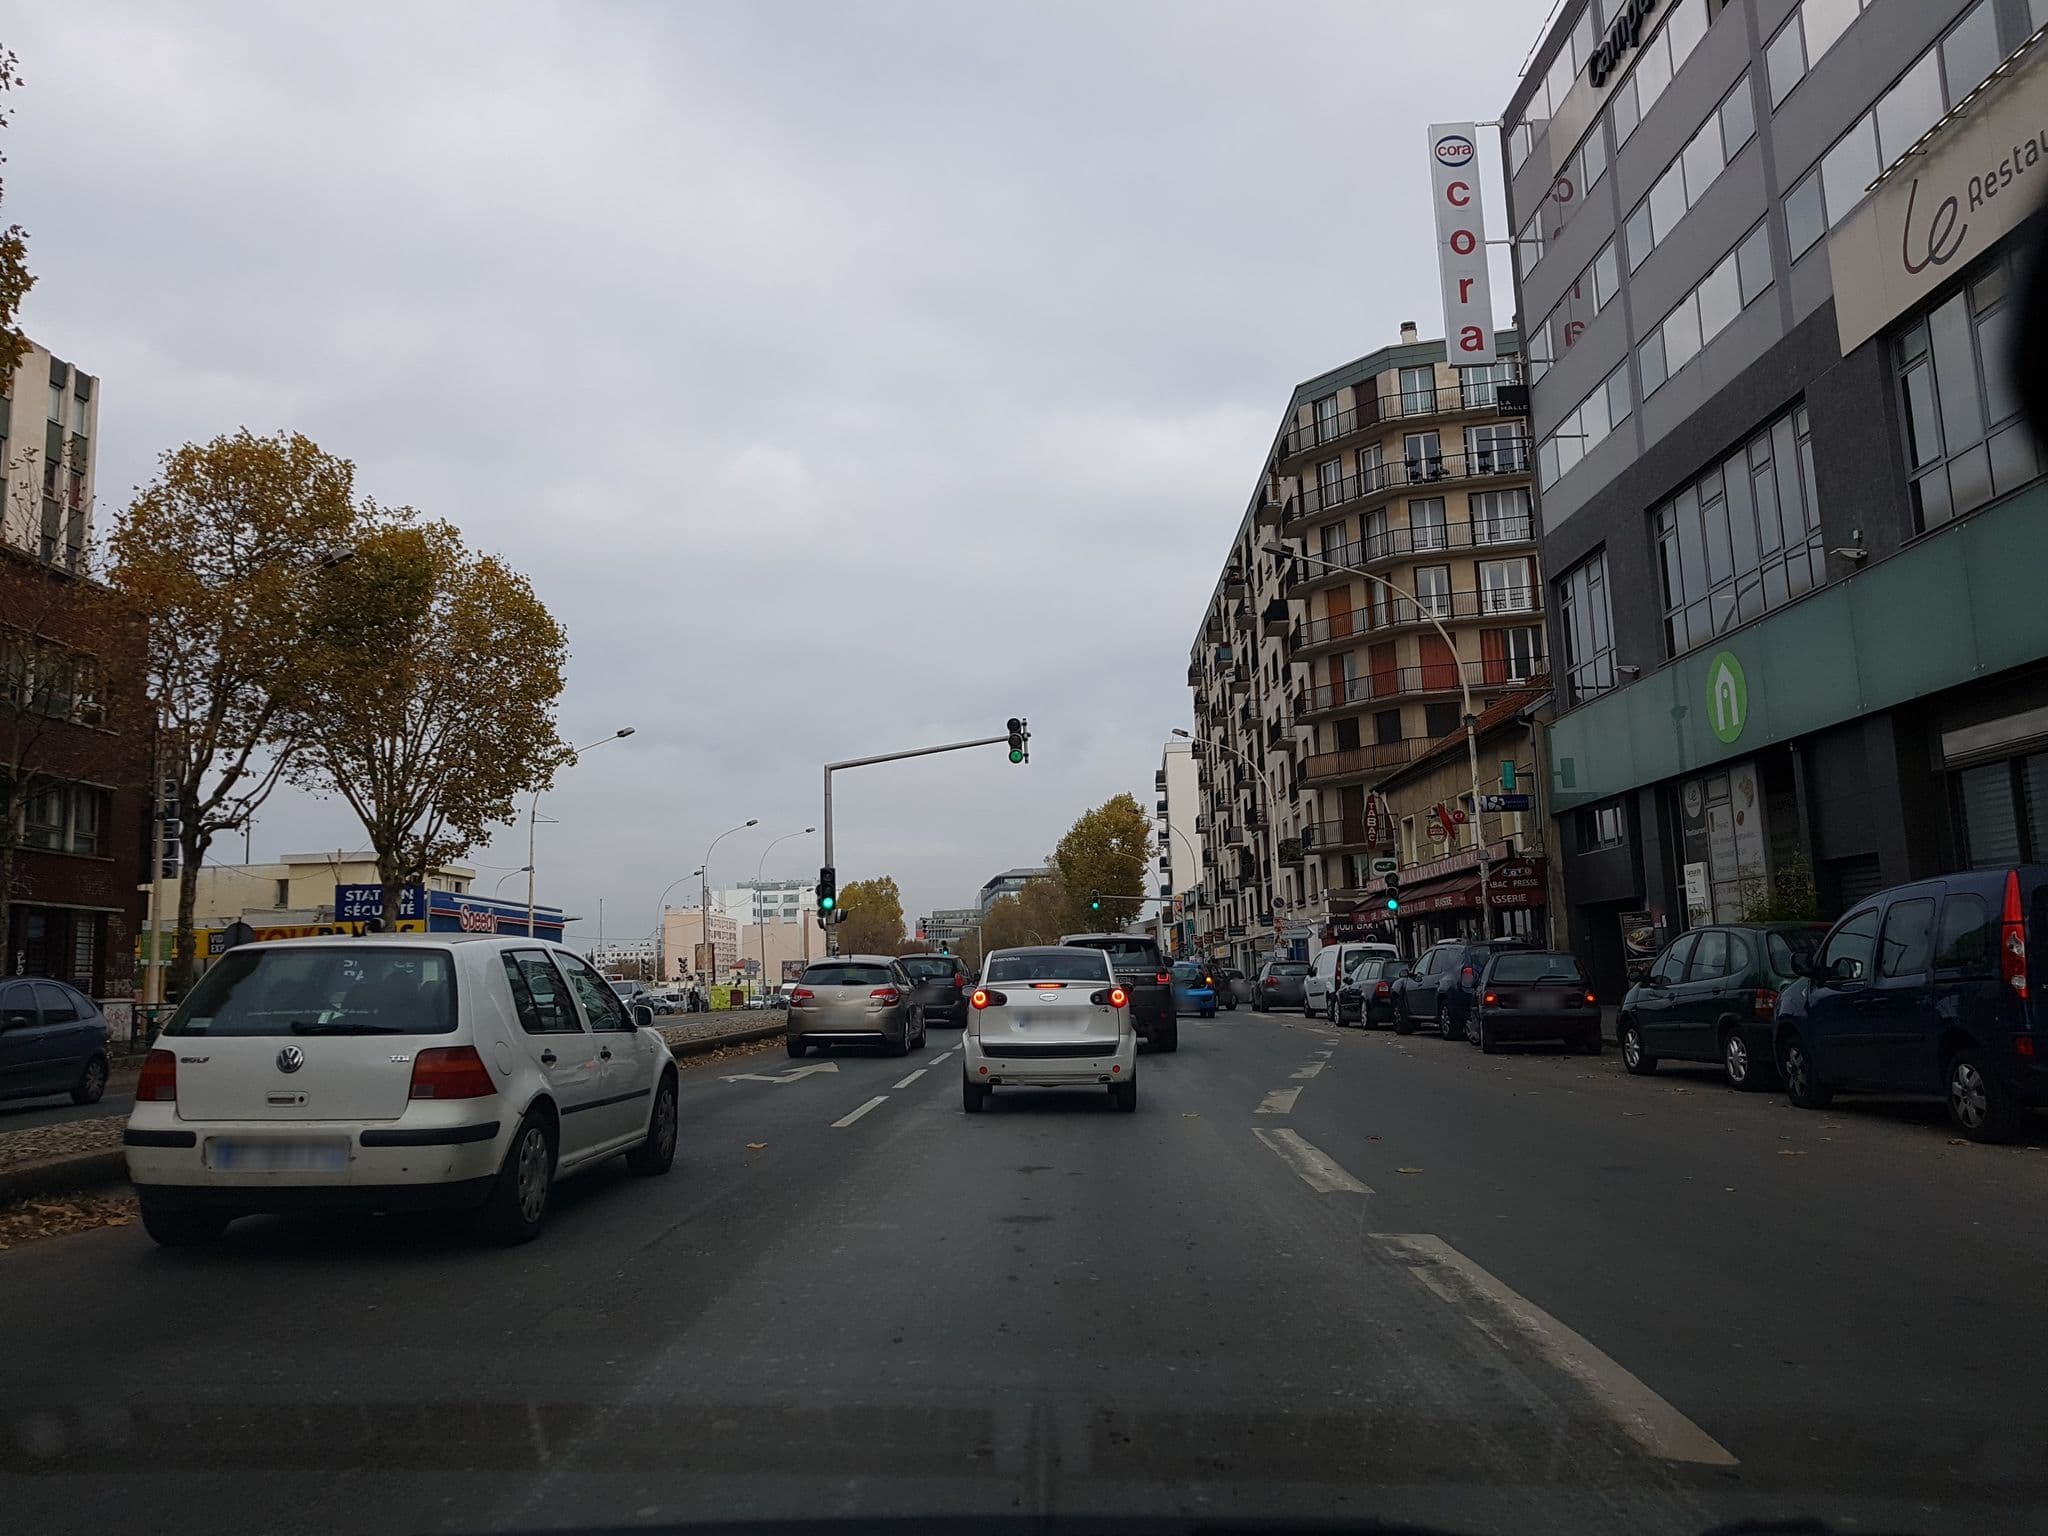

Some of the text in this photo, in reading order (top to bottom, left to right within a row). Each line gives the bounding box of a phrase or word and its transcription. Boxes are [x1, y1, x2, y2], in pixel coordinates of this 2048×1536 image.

[1438, 144, 1471, 156] cora
[1367, 802, 1377, 842] TABAC
[1489, 879, 1541, 889] ABAC PRESSE
[344, 889, 415, 901] STATN
[1475, 893, 1528, 905] BASSERIE
[343, 902, 415, 917] SÉCUTÉ
[460, 903, 498, 934] Speedy
